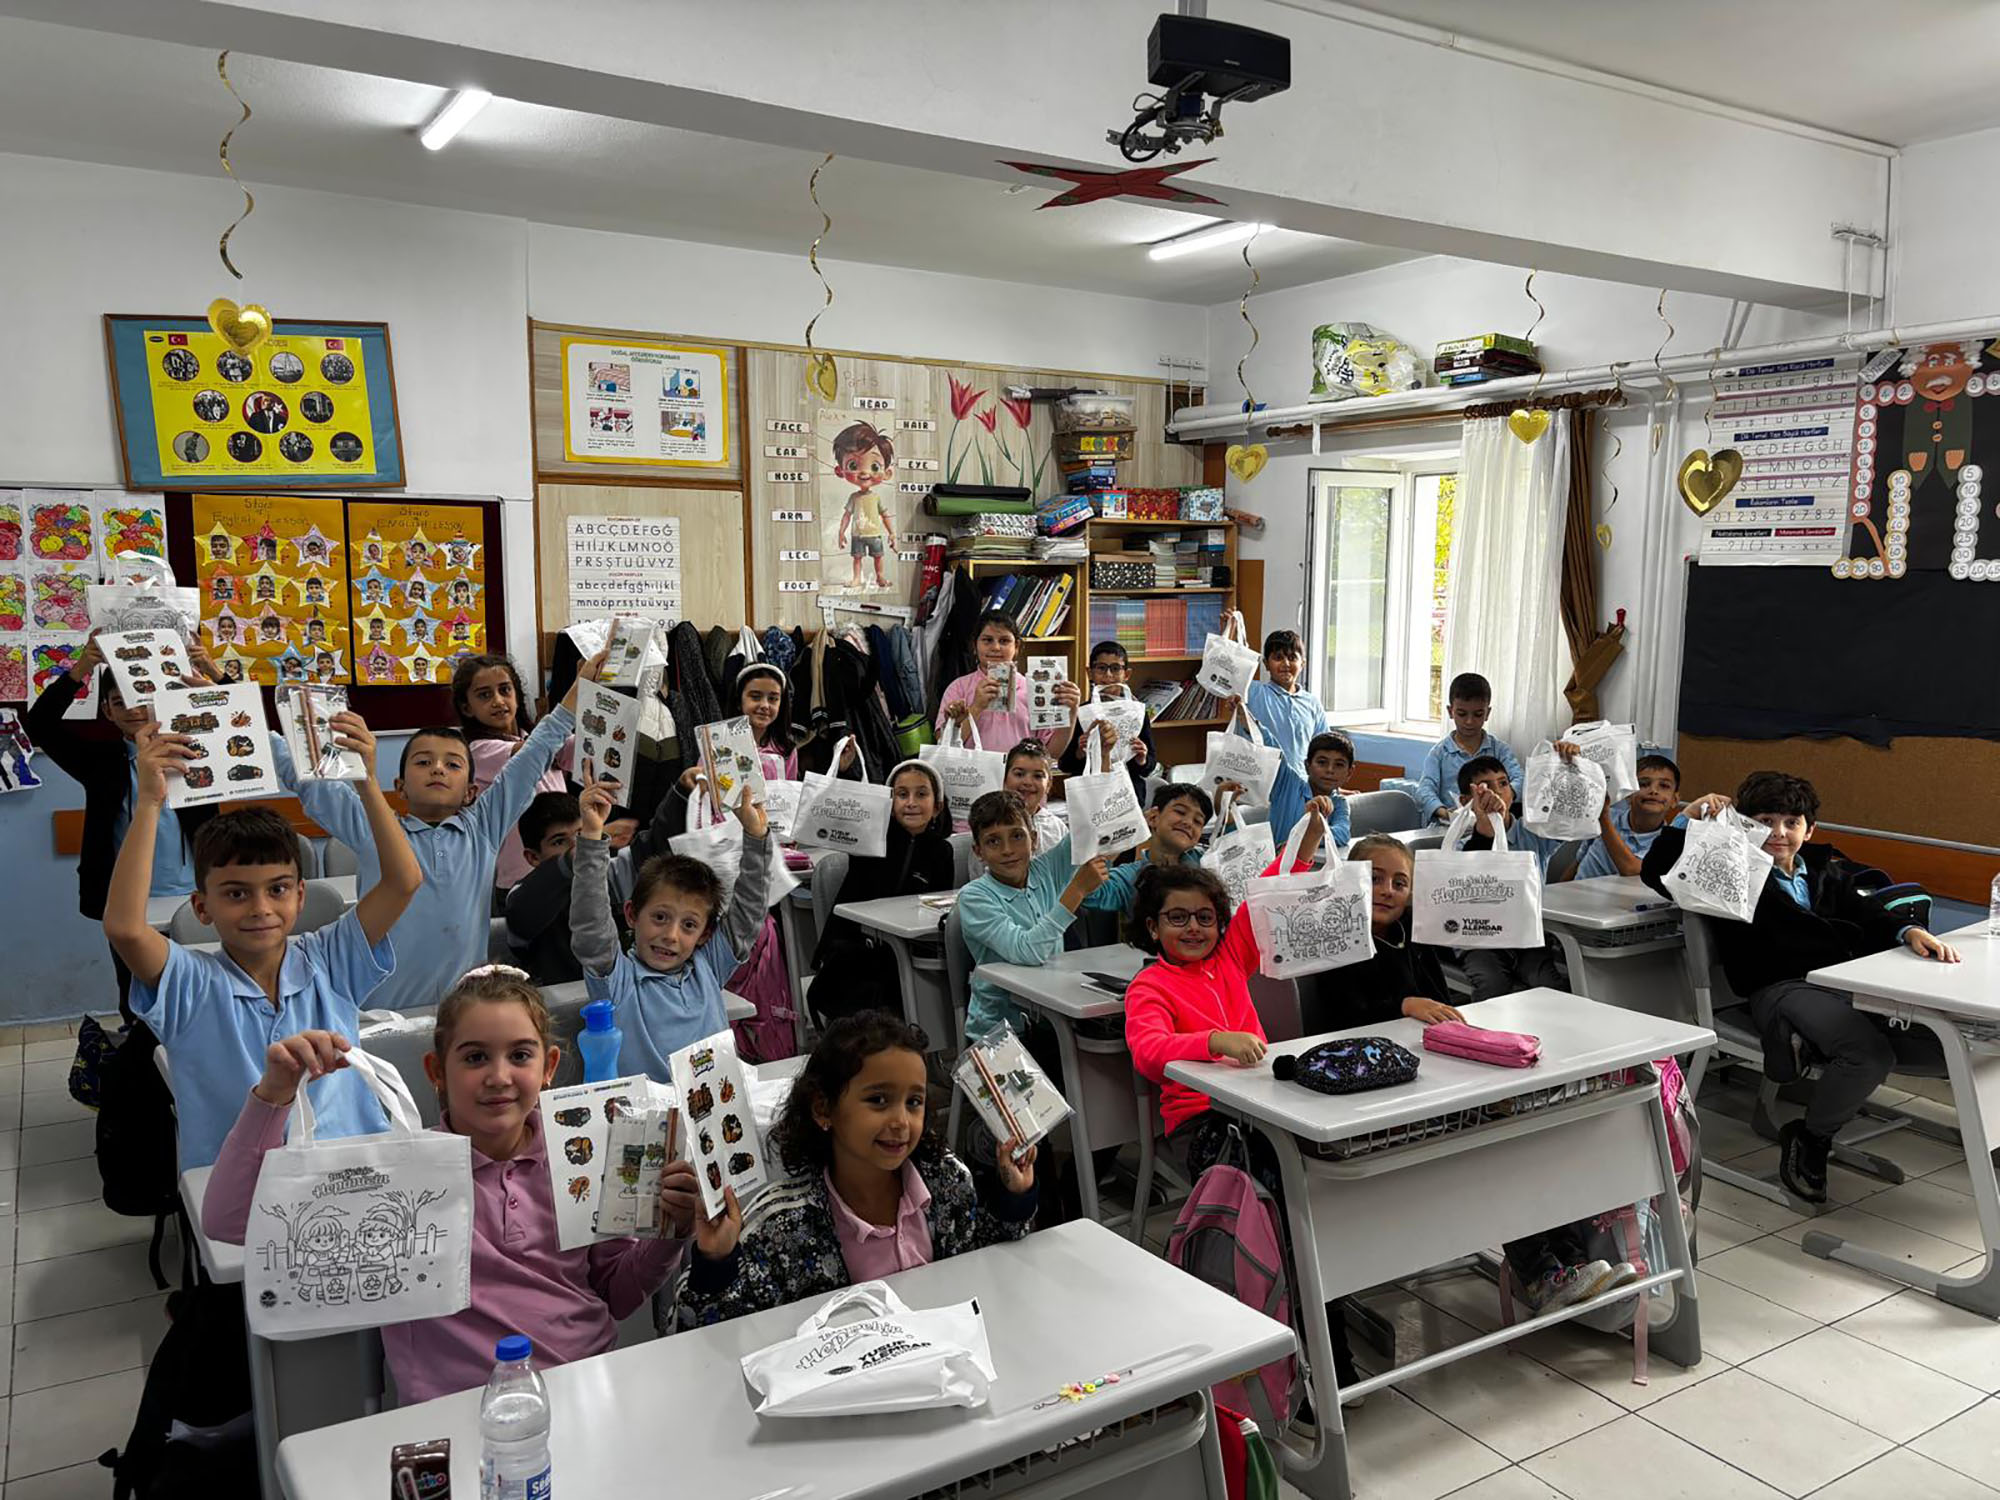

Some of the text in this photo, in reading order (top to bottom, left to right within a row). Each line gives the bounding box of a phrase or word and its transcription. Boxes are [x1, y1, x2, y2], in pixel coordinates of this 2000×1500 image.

[860, 399, 888, 409] HEAD
[774, 422, 802, 432] FACE
[903, 421, 929, 429] HAIR
[776, 448, 797, 456] EAR
[908, 460, 928, 469] EYE
[775, 472, 803, 481] NOSE
[901, 484, 932, 492] MOUT
[780, 512, 803, 520] ARM
[788, 552, 809, 560] LEG
[898, 552, 924, 561] FING
[784, 582, 812, 590] FOOT
[1462, 918, 1491, 926] YUSUF
[1462, 924, 1503, 932] ALEMDAR
[858, 1339, 906, 1362] YUSUF
[861, 1342, 932, 1367] ALEMDAR
